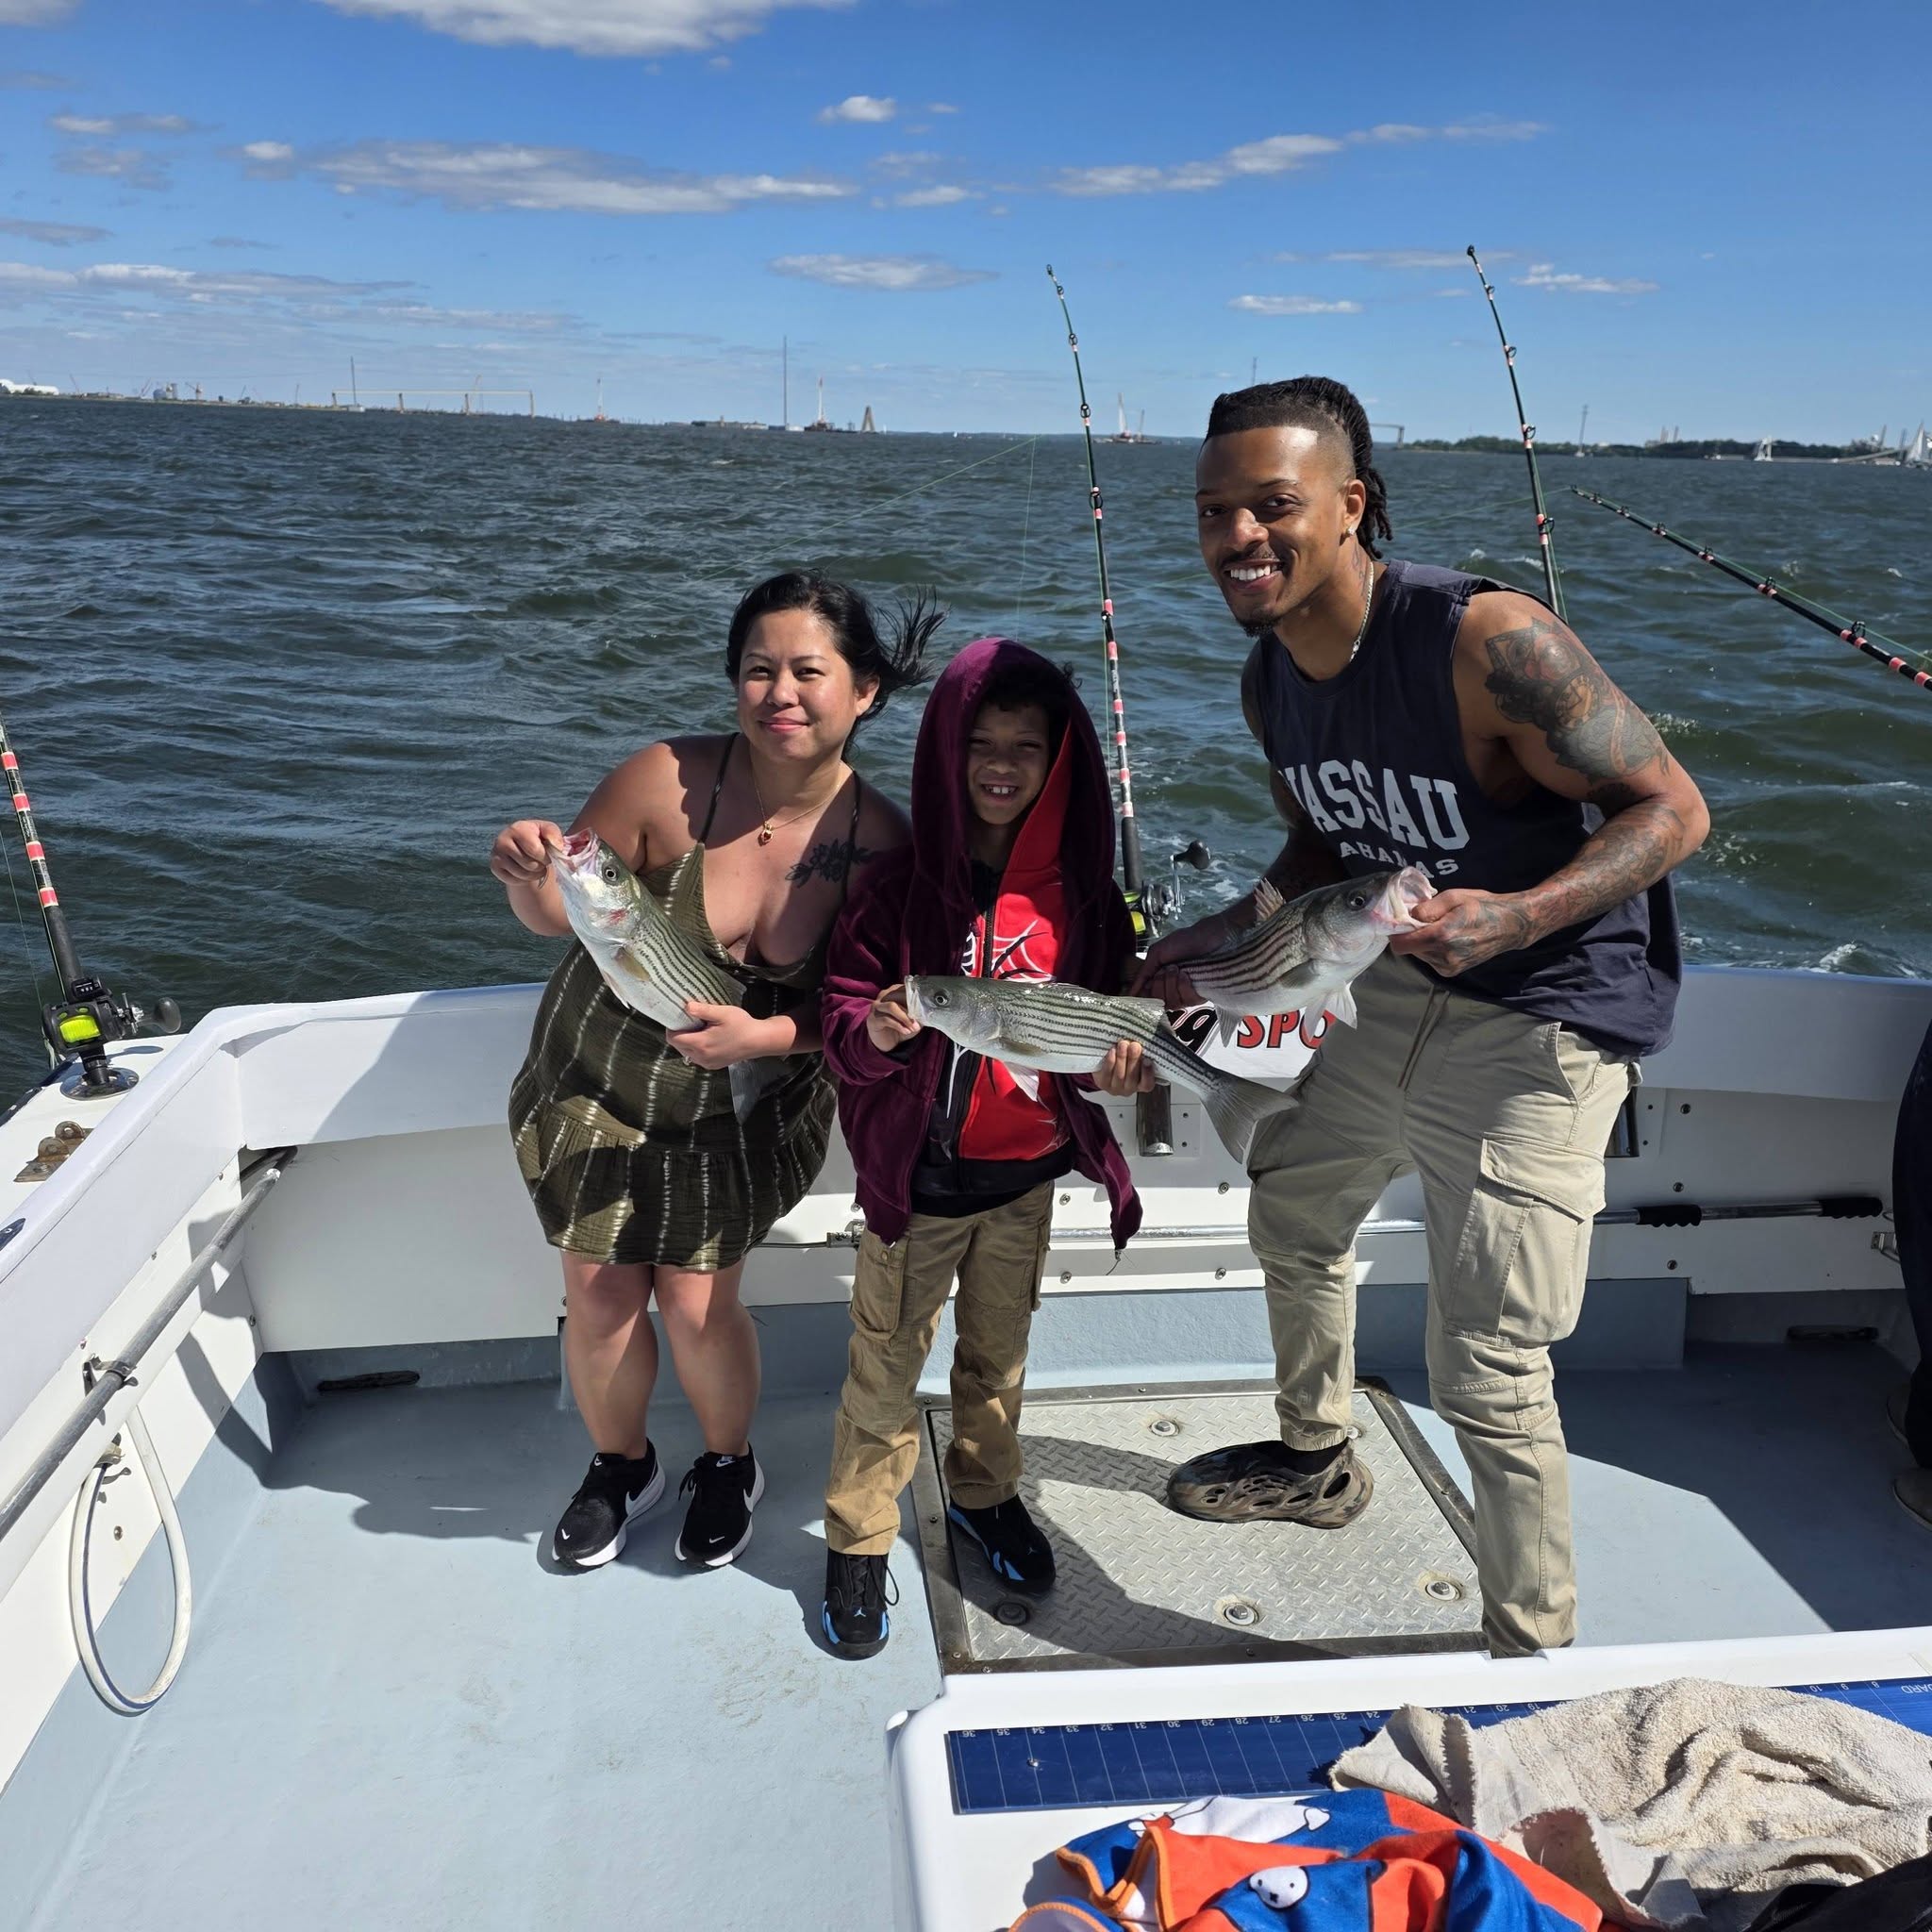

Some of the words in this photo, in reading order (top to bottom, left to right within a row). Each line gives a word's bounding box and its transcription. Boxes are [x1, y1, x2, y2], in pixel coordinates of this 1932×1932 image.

[1366, 1710, 1380, 1719] 24
[1463, 1706, 1476, 1714] 21
[1167, 1720, 1181, 1728] 30
[1269, 1715, 1282, 1724] 27
[1032, 1726, 1045, 1735] 34
[1065, 1724, 1079, 1733] 33
[962, 1729, 976, 1738] 36
